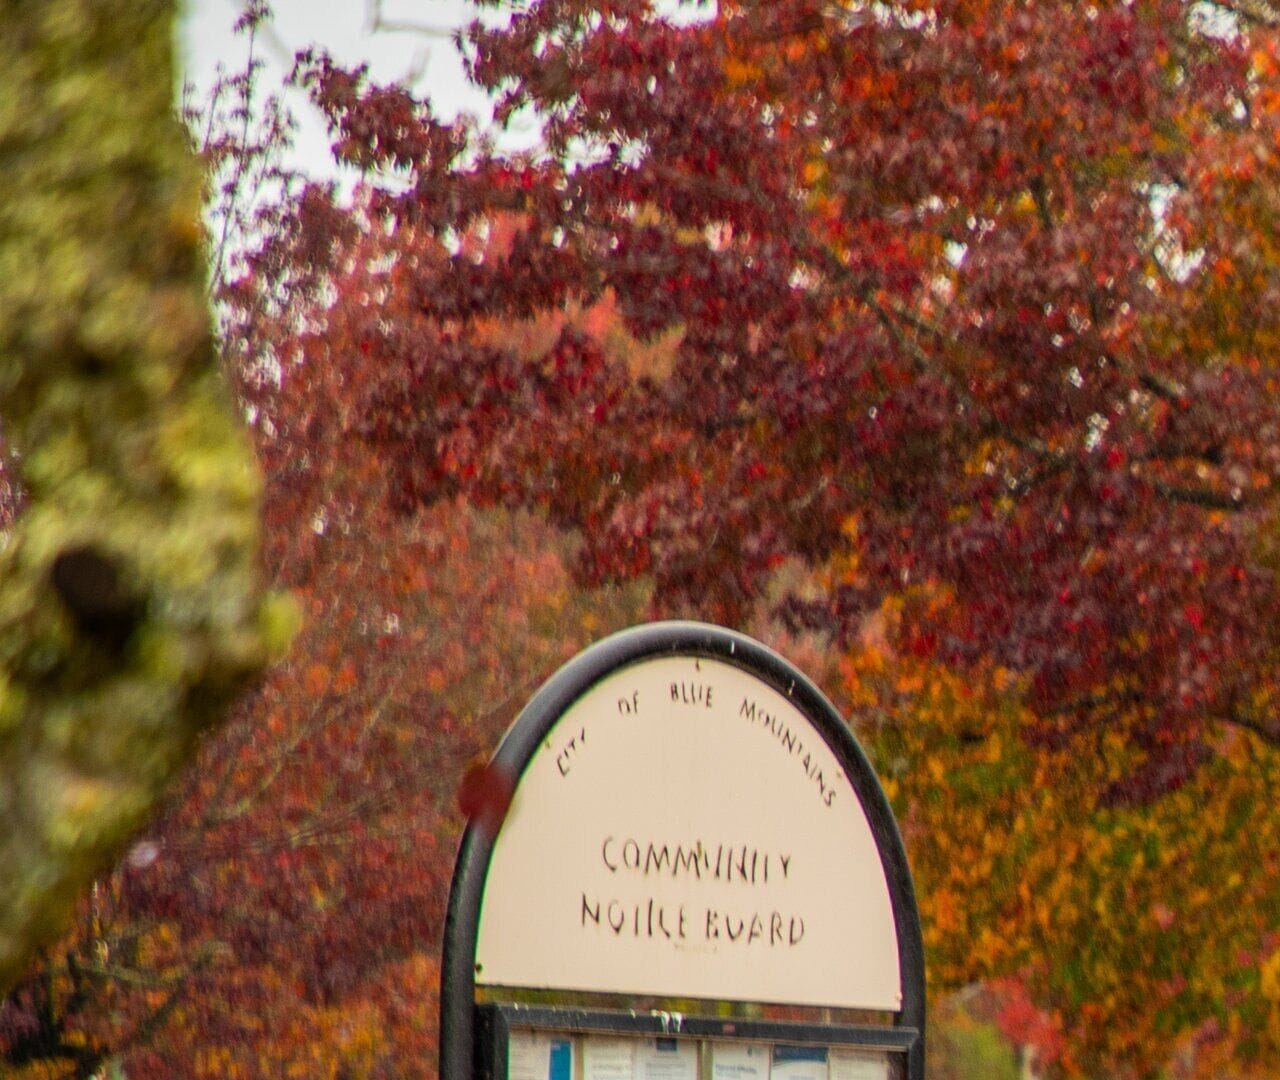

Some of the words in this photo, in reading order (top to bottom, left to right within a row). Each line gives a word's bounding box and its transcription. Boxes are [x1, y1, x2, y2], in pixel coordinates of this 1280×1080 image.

[556, 727, 587, 777] CITY
[617, 689, 639, 715] OF
[669, 681, 713, 709] BLUE
[739, 697, 837, 808] MOUNTAINS
[602, 836, 793, 885] COMMUNITY
[581, 890, 686, 939] NOTICE
[705, 908, 805, 947] BOARD
